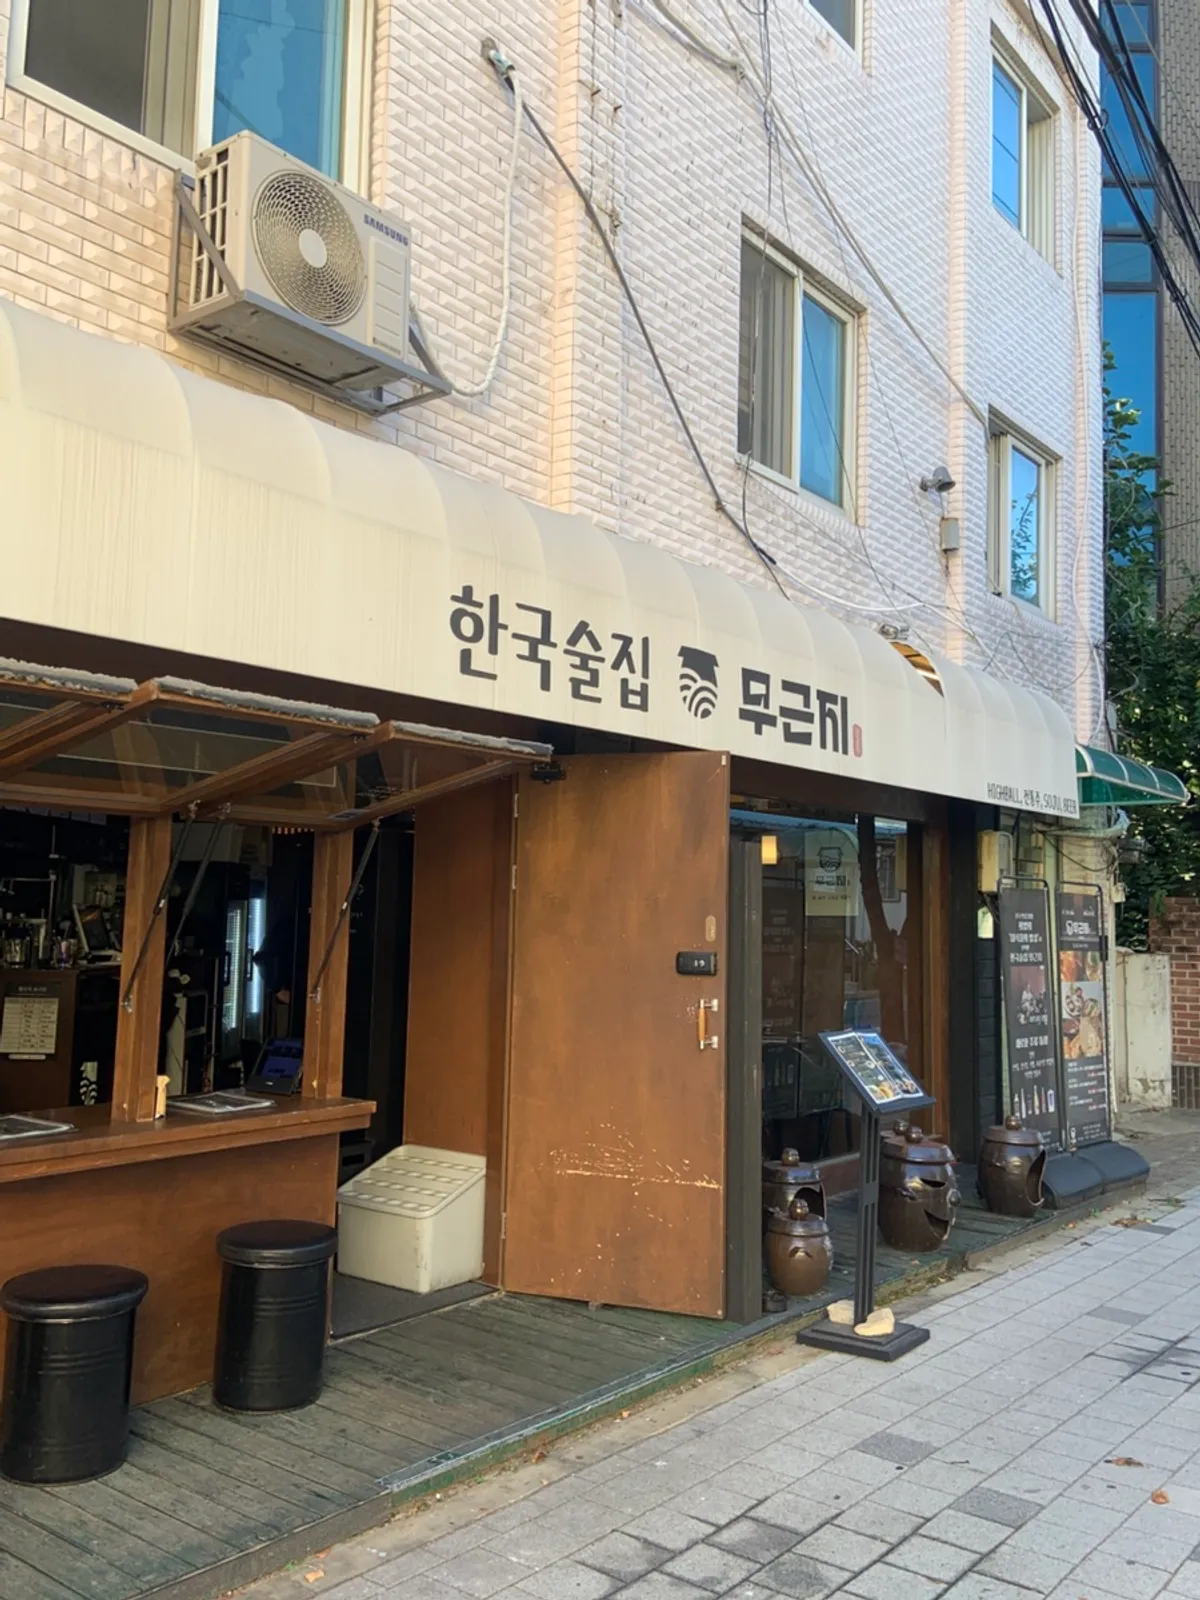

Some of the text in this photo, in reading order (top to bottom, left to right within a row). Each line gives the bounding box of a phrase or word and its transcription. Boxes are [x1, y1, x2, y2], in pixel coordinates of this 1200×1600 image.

[363, 213, 409, 246] SAMSUNG
[450, 585, 849, 756] 한국술집 무근지
[1063, 798, 1077, 815] BEER
